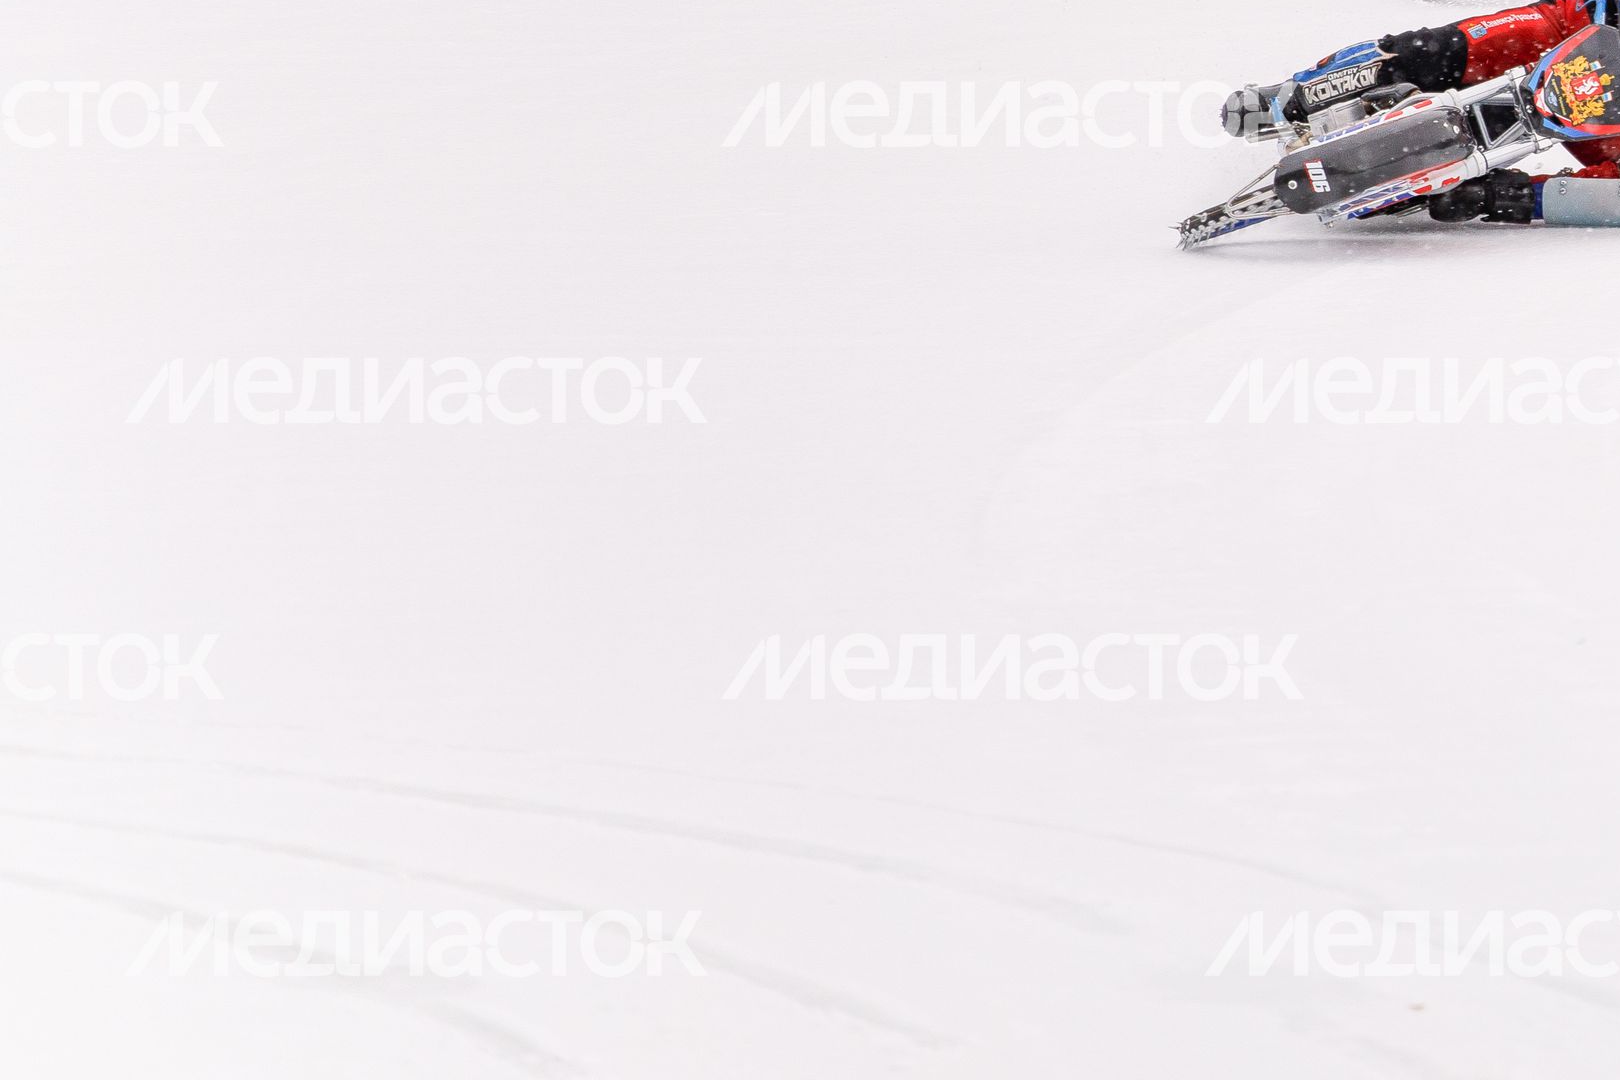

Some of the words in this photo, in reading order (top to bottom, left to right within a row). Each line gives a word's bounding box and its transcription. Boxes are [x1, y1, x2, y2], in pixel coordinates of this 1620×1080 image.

[1304, 66, 1378, 106] KOLTAKOV
[1327, 67, 1359, 81] DMITRY
[1302, 159, 1332, 195] 106
